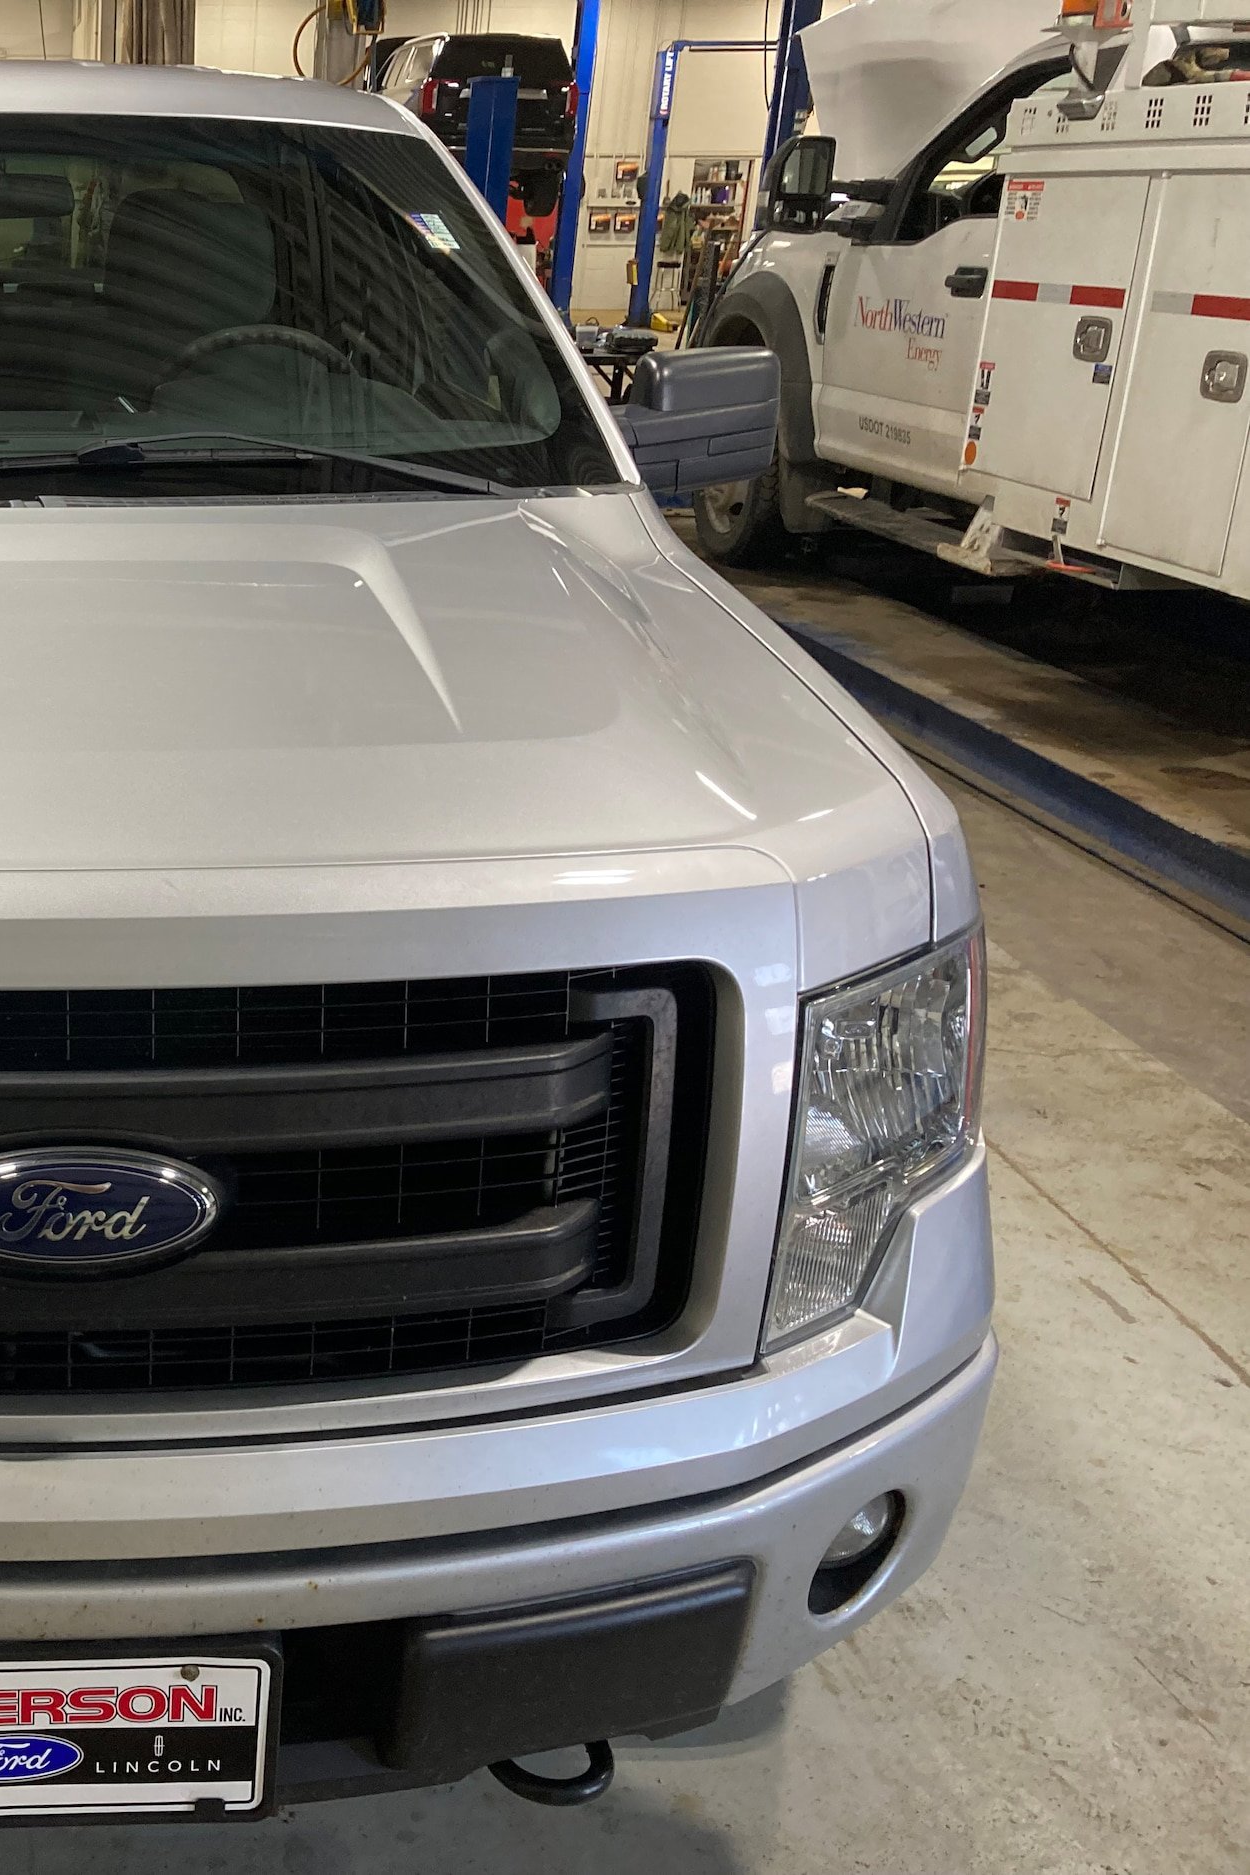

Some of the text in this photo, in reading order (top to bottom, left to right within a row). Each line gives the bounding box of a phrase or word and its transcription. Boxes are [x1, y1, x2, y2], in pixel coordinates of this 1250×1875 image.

[854, 295, 946, 339] NorthWestern
[906, 337, 942, 371] Energy
[858, 415, 884, 437] USDOT
[219, 1707, 245, 1722] INC.
[96, 1759, 222, 1774] LINCOLN
